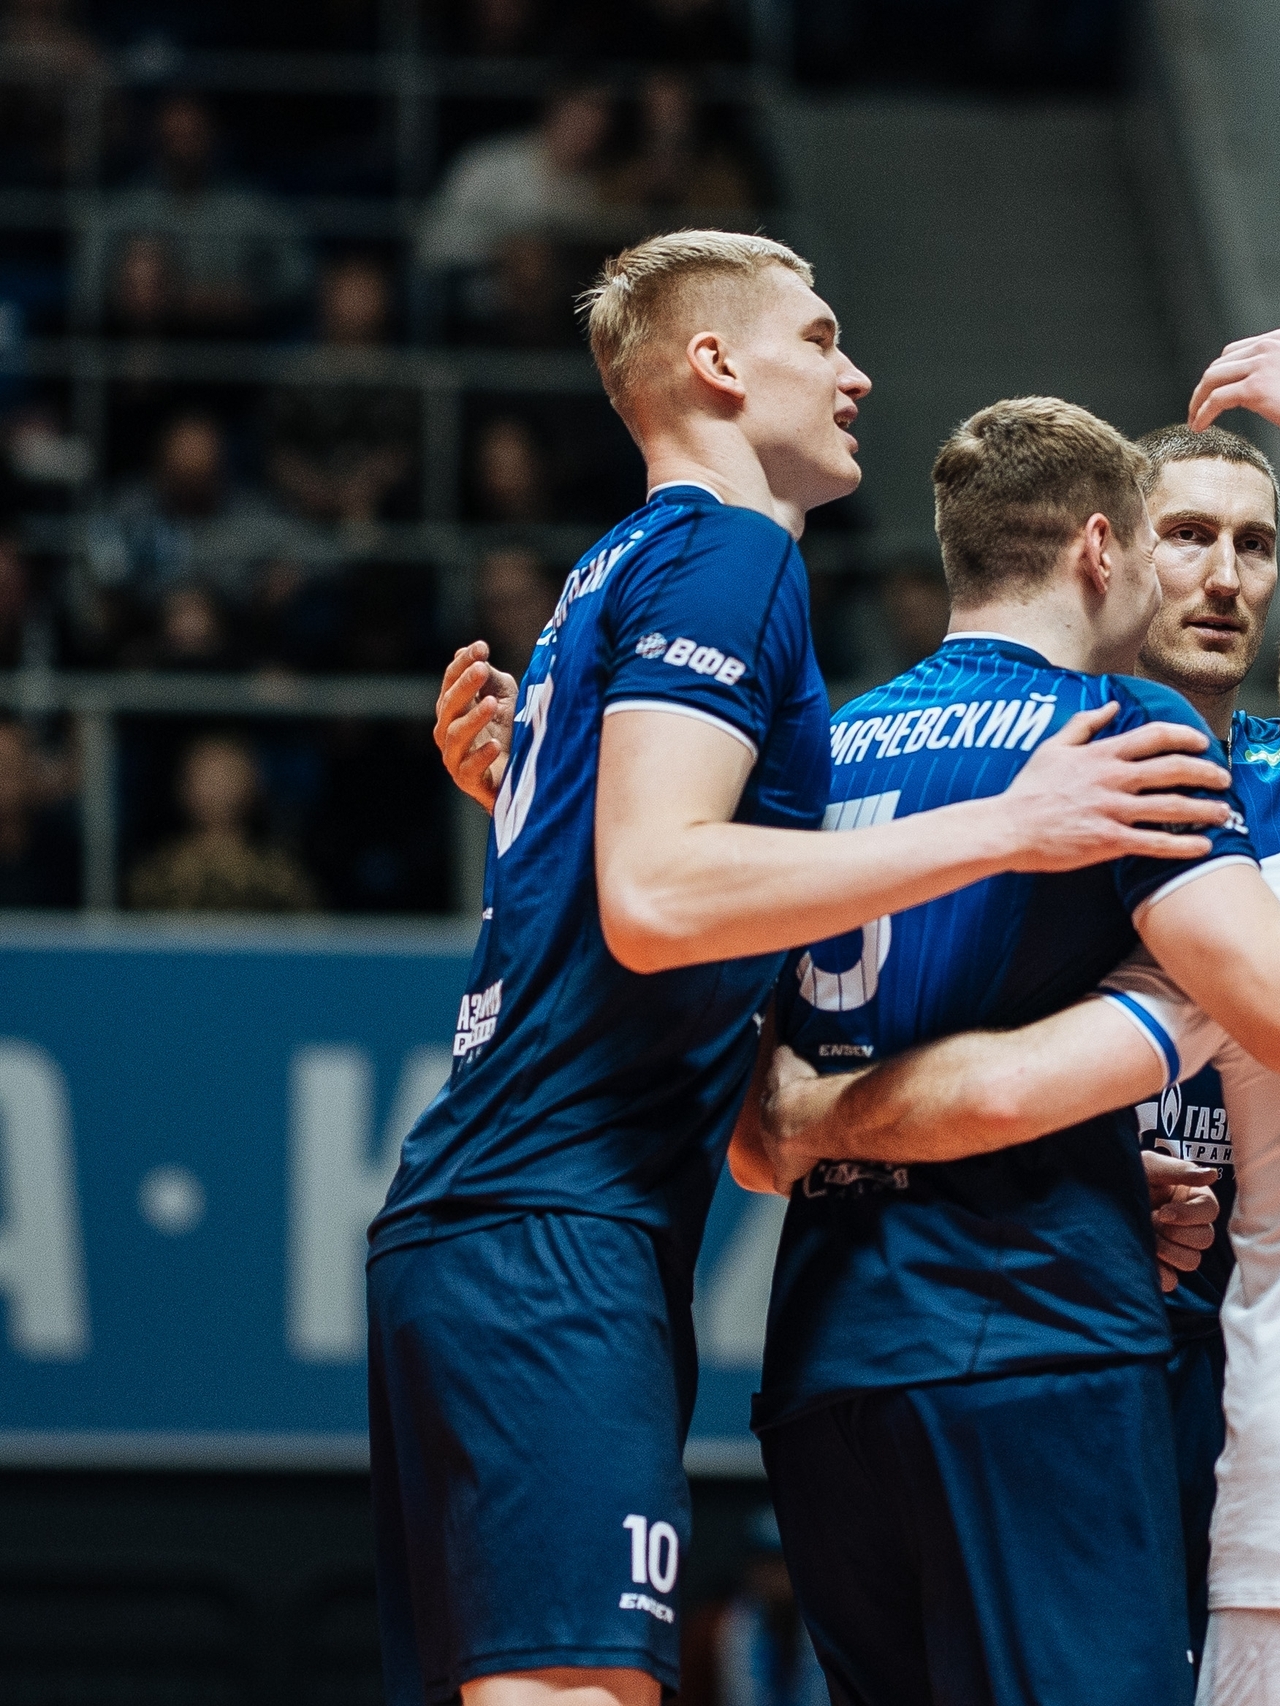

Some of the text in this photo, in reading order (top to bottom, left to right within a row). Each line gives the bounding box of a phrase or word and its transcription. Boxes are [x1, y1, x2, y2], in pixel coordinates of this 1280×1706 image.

[662, 636, 747, 687] ВФВ
[830, 692, 1058, 765] МАЧЕВСКИЙ
[622, 1513, 679, 1594] 10
